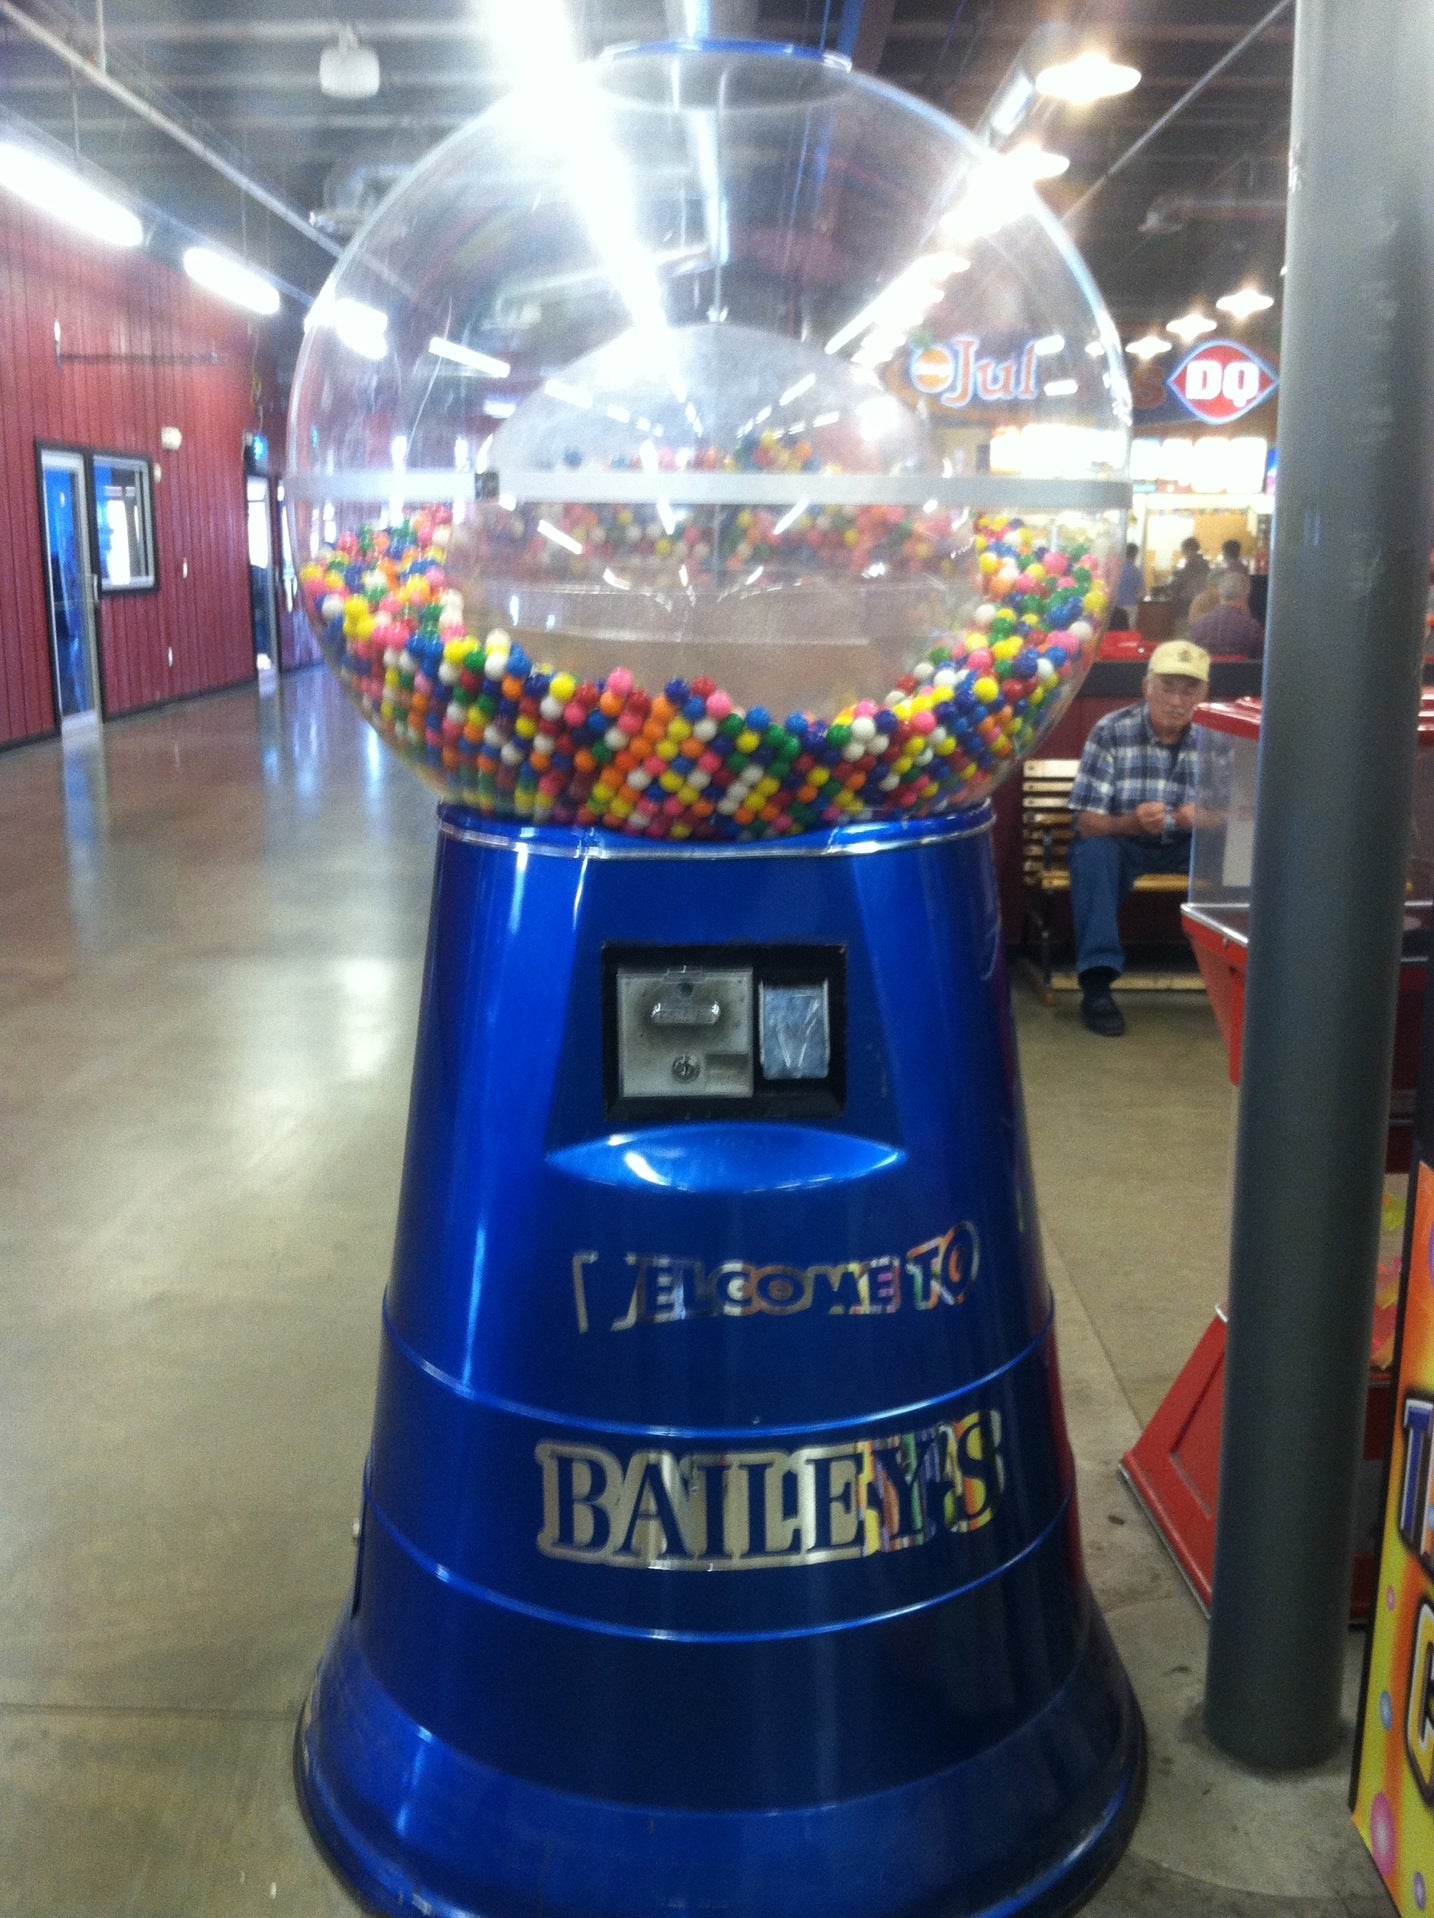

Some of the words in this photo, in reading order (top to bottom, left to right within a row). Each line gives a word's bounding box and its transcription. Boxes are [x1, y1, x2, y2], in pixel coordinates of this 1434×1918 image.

[1185, 359, 1260, 408] DQ
[572, 1251, 901, 1334] WELCOME
[905, 1221, 981, 1310] TO
